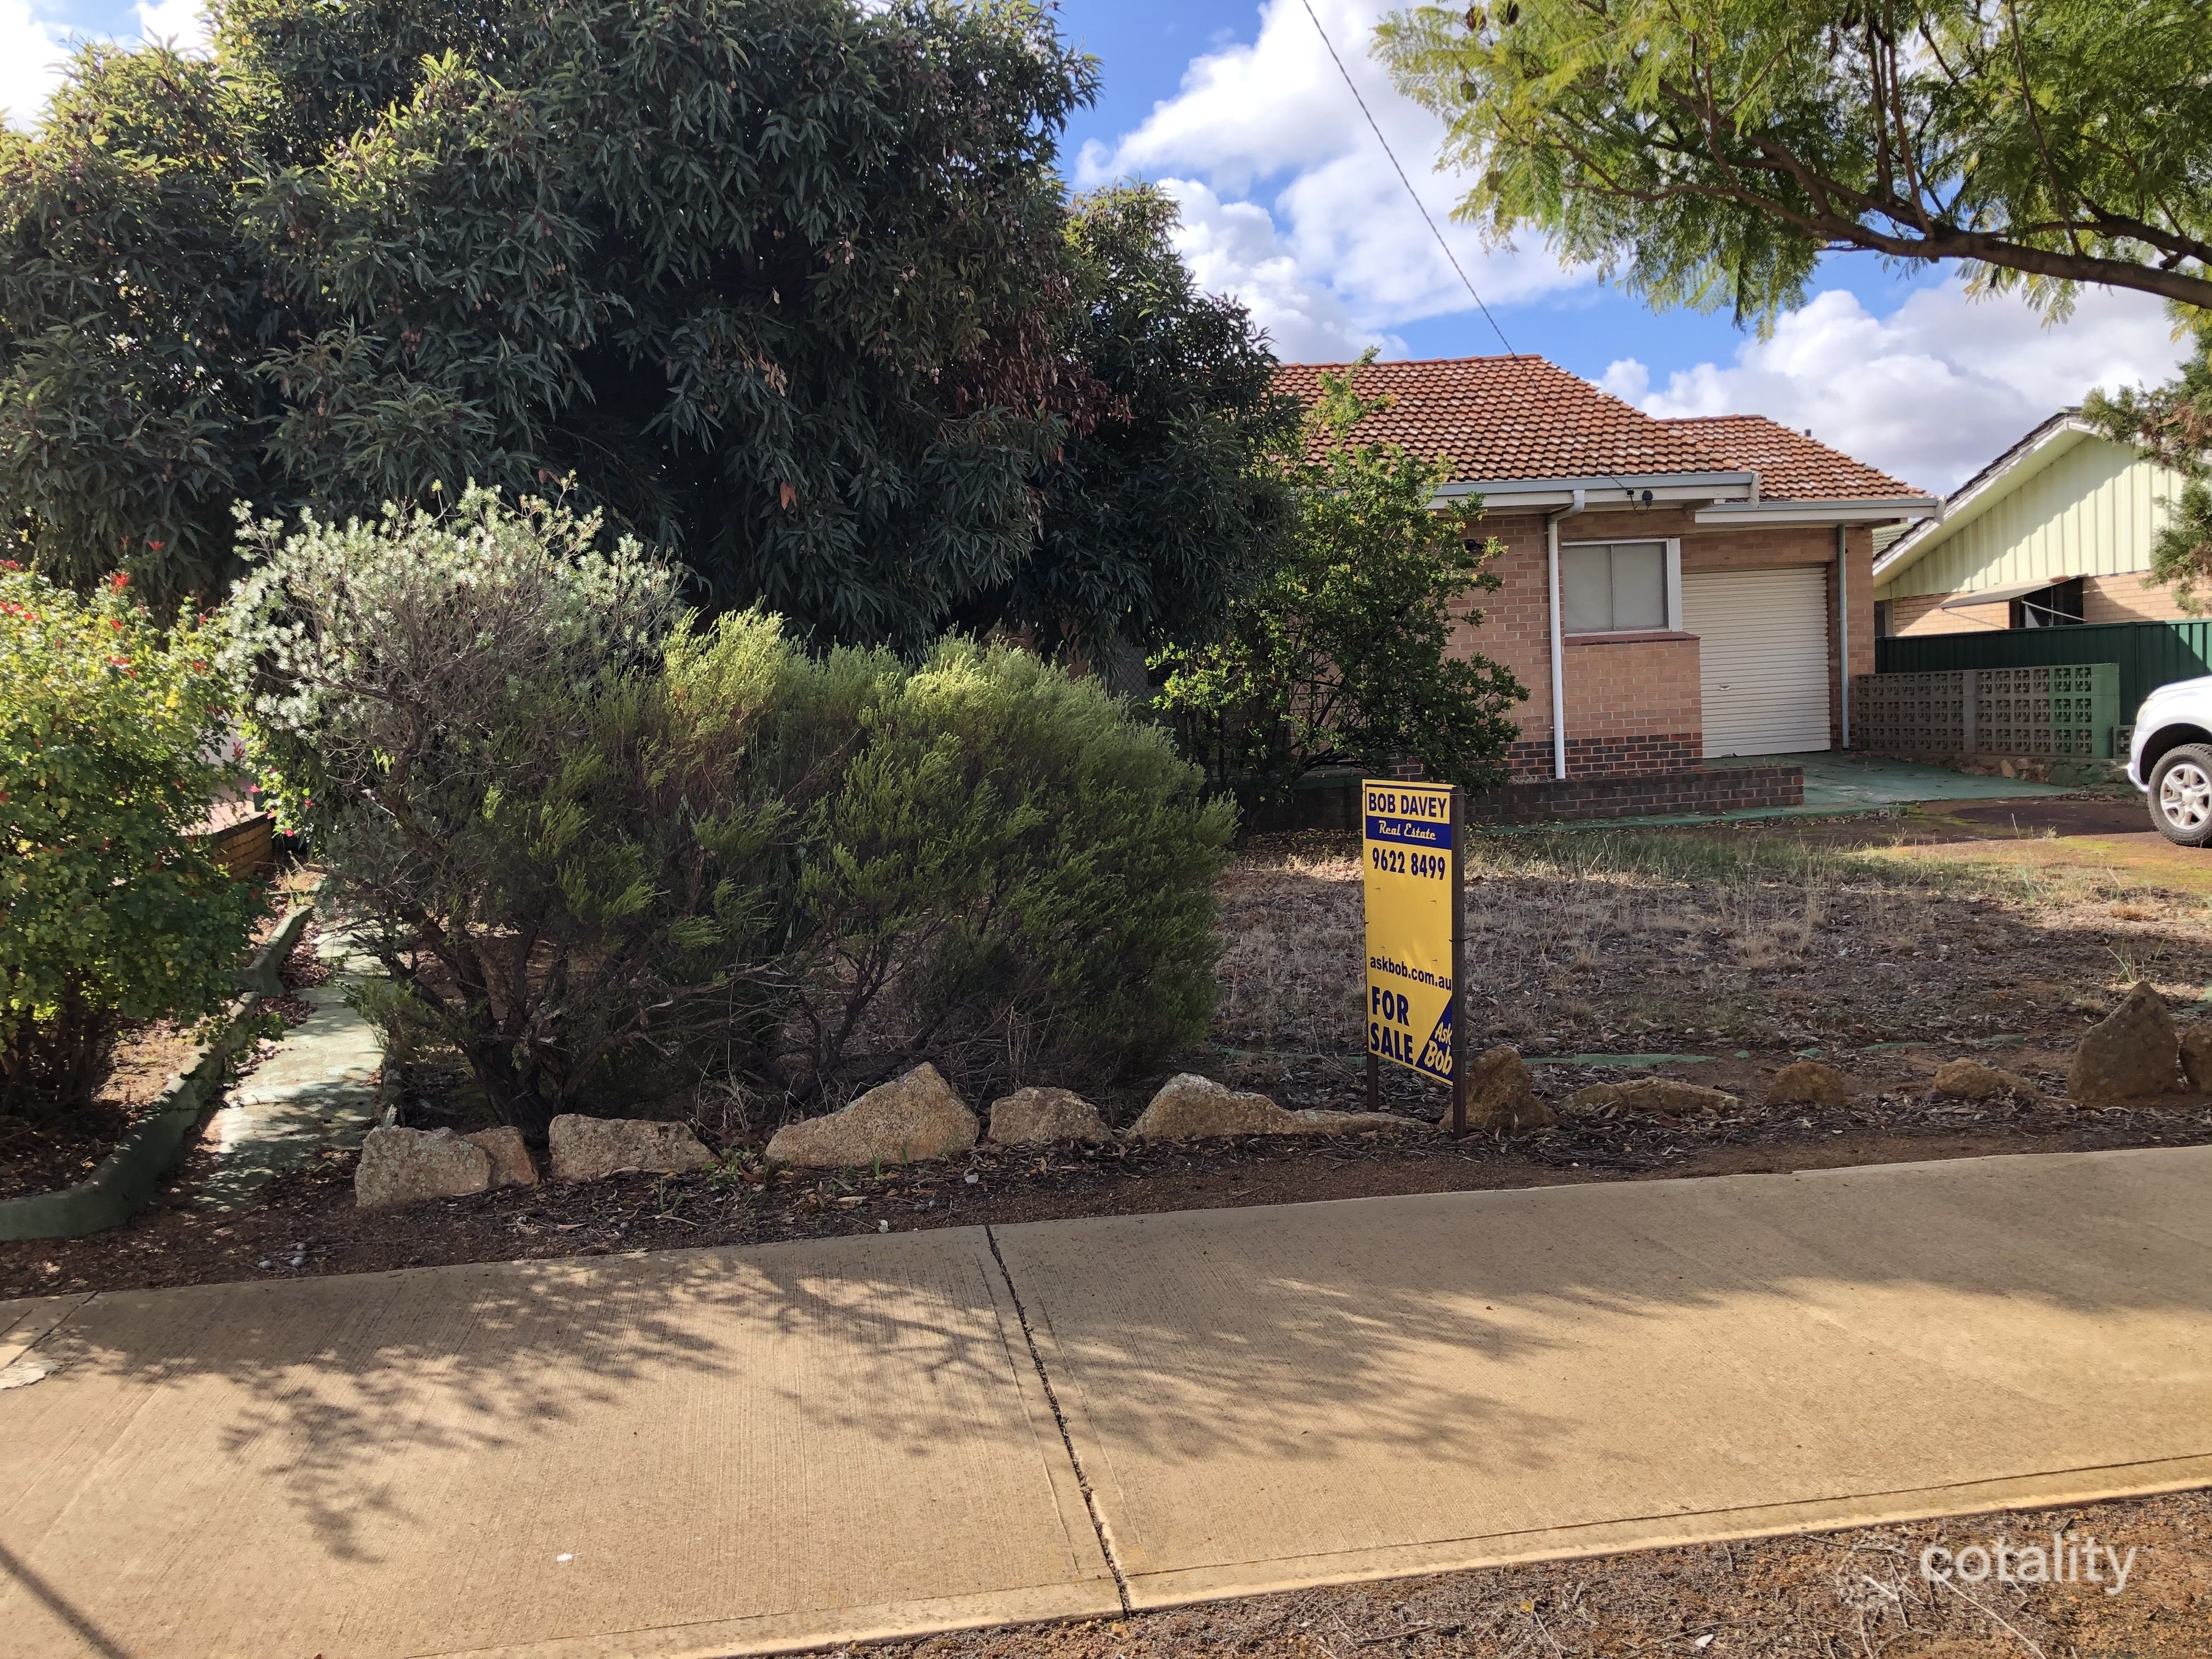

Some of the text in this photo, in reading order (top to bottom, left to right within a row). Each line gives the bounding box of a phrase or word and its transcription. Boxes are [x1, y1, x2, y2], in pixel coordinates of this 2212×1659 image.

[1369, 792, 1447, 818] BOB DAVEY
[1378, 820, 1436, 840] Real Estate
[1372, 847, 1446, 880] 9622 8499
[1370, 956, 1452, 991] askbob.com.au
[1372, 986, 1409, 1026] FOR
[1370, 1022, 1414, 1065] SALE
[1434, 1022, 1453, 1045] Ask
[1424, 1040, 1453, 1075] Bob
